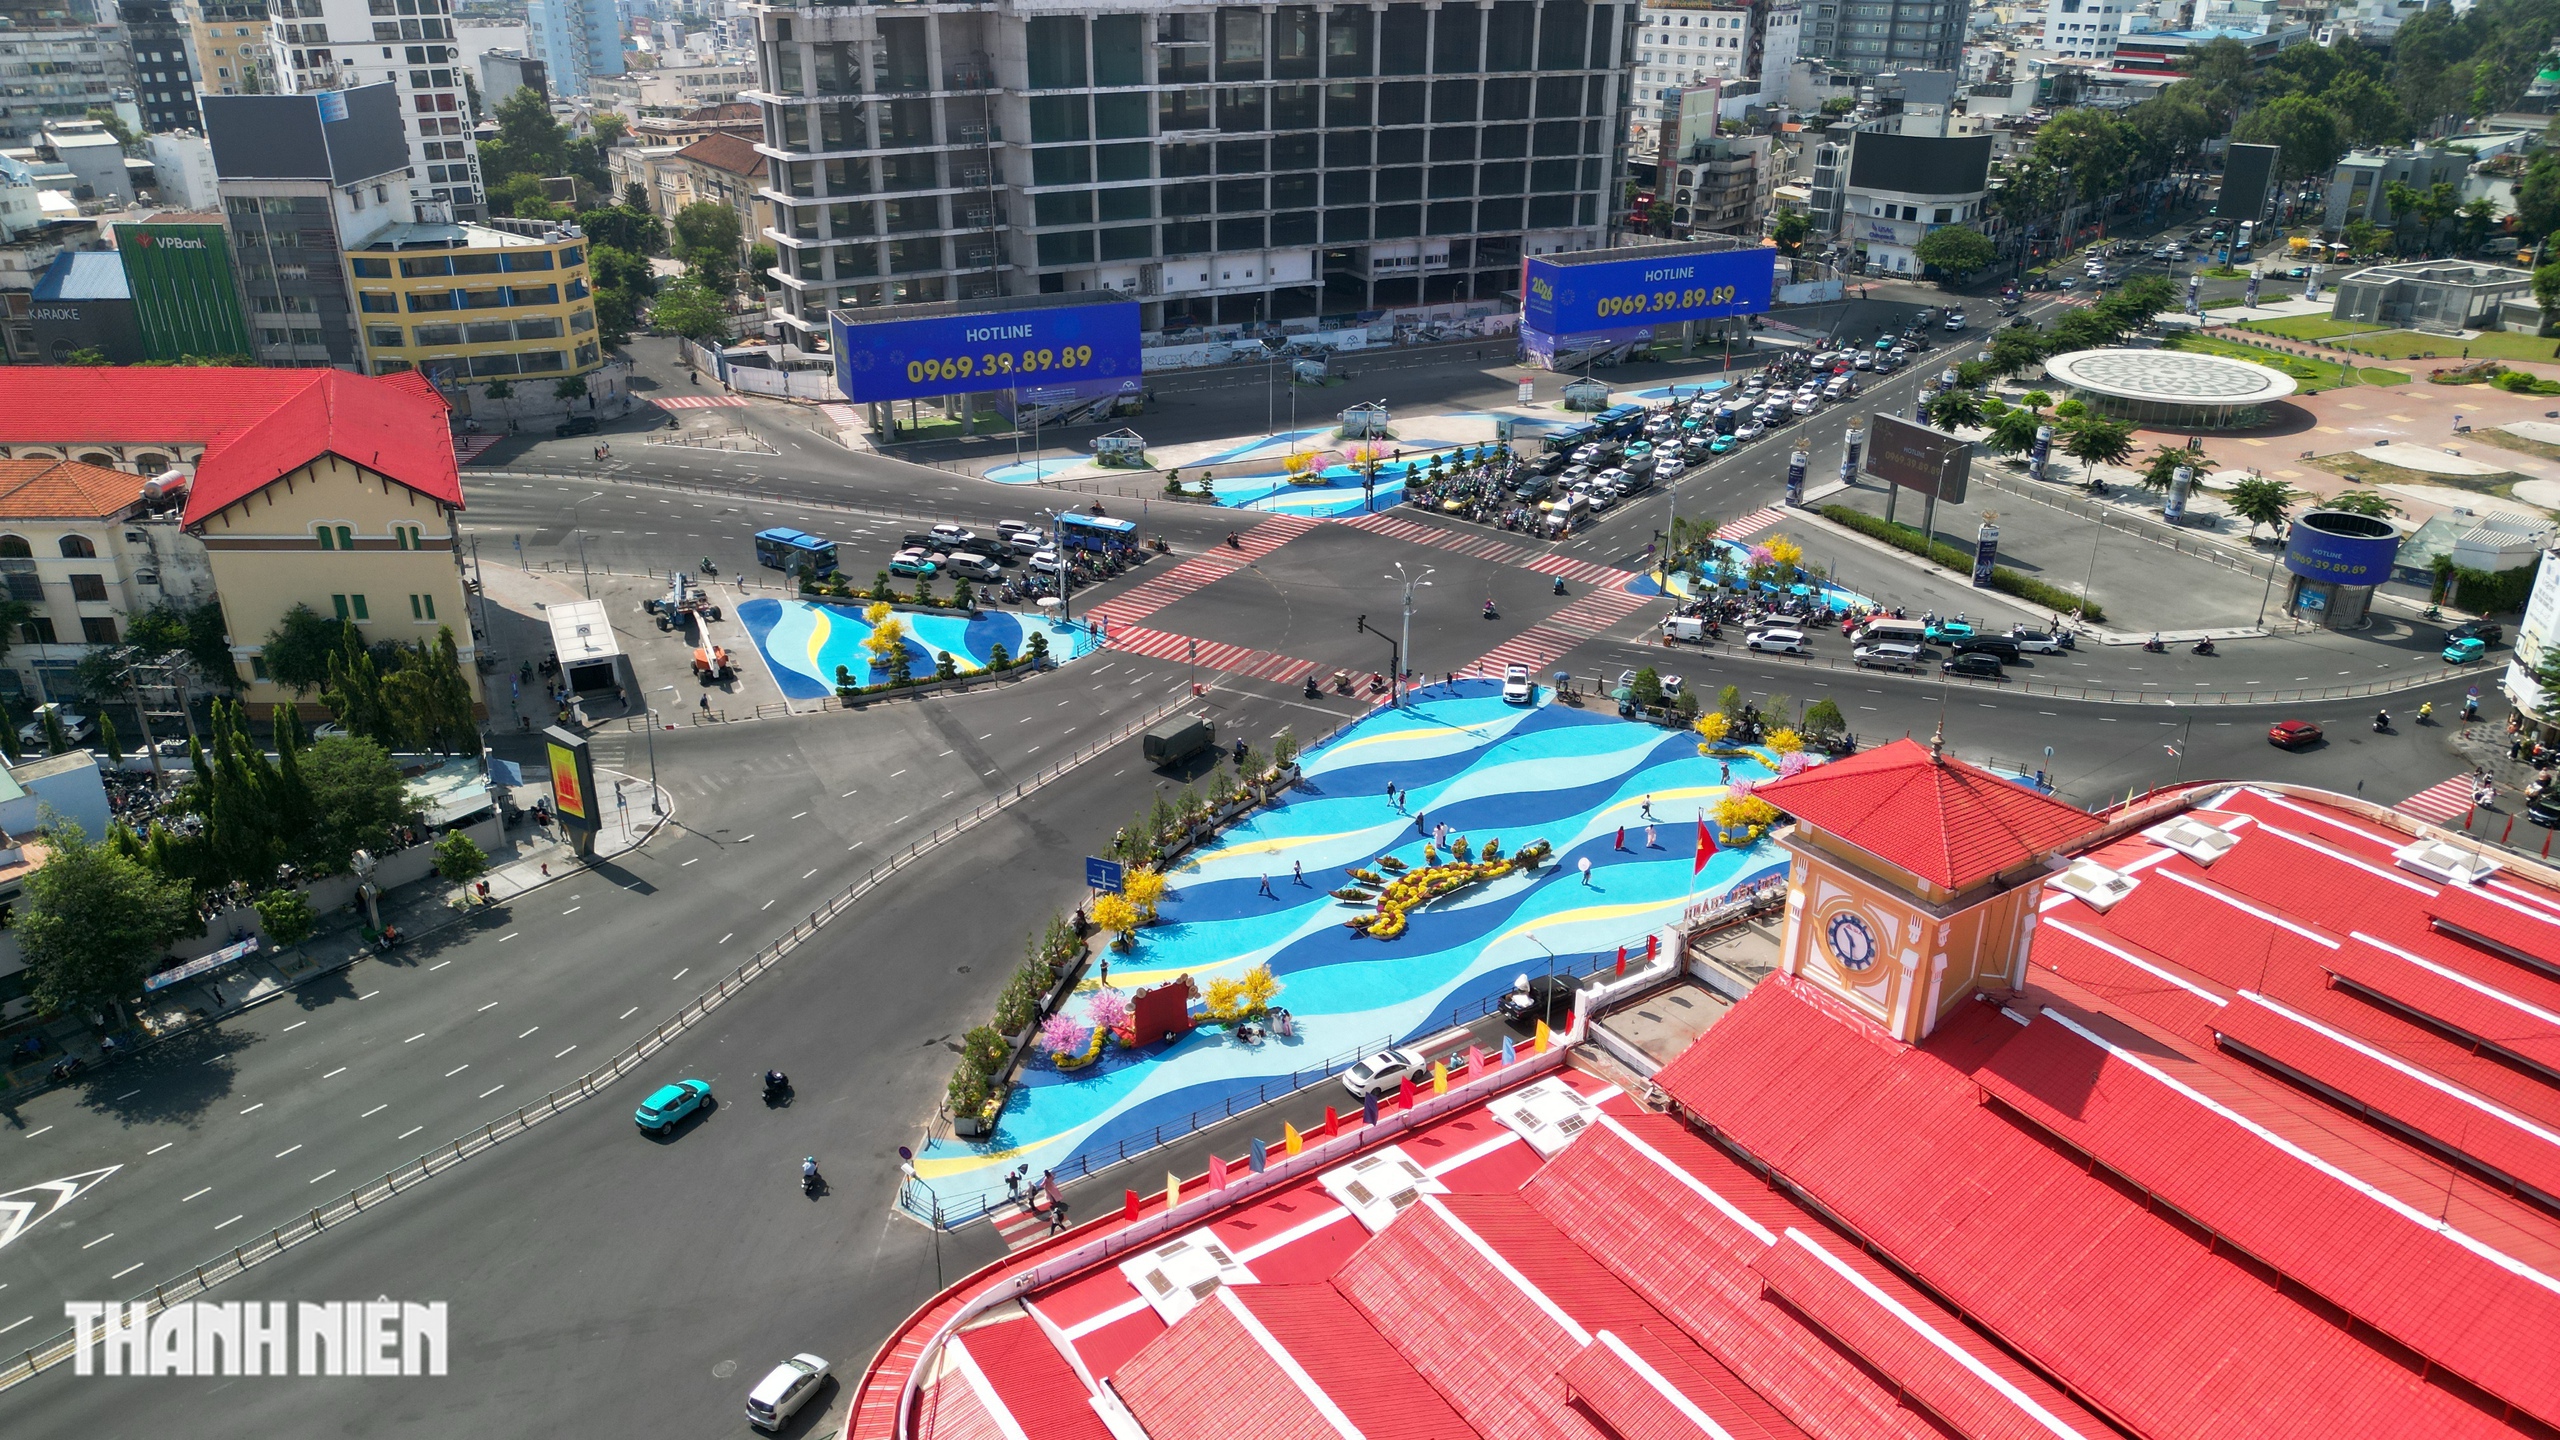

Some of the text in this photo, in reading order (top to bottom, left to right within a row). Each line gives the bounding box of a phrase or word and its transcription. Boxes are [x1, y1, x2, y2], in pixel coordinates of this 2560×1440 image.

[452, 67, 462, 87] EL
[467, 153, 485, 204] REALM
[156, 237, 207, 249] VPBank
[1645, 266, 1695, 282] HOTLINE
[1531, 276, 1553, 301] 2026
[1597, 285, 1736, 318] 0969.39.89.89
[29, 308, 80, 321] KARAOKE
[966, 324, 1033, 342] HOTLINE
[907, 345, 1092, 383] 0969.39.89.89
[1903, 446, 1926, 459] HOTLINE
[2312, 547, 2343, 559] HOTLINE
[2291, 551, 2367, 574] 0969.39.89.89
